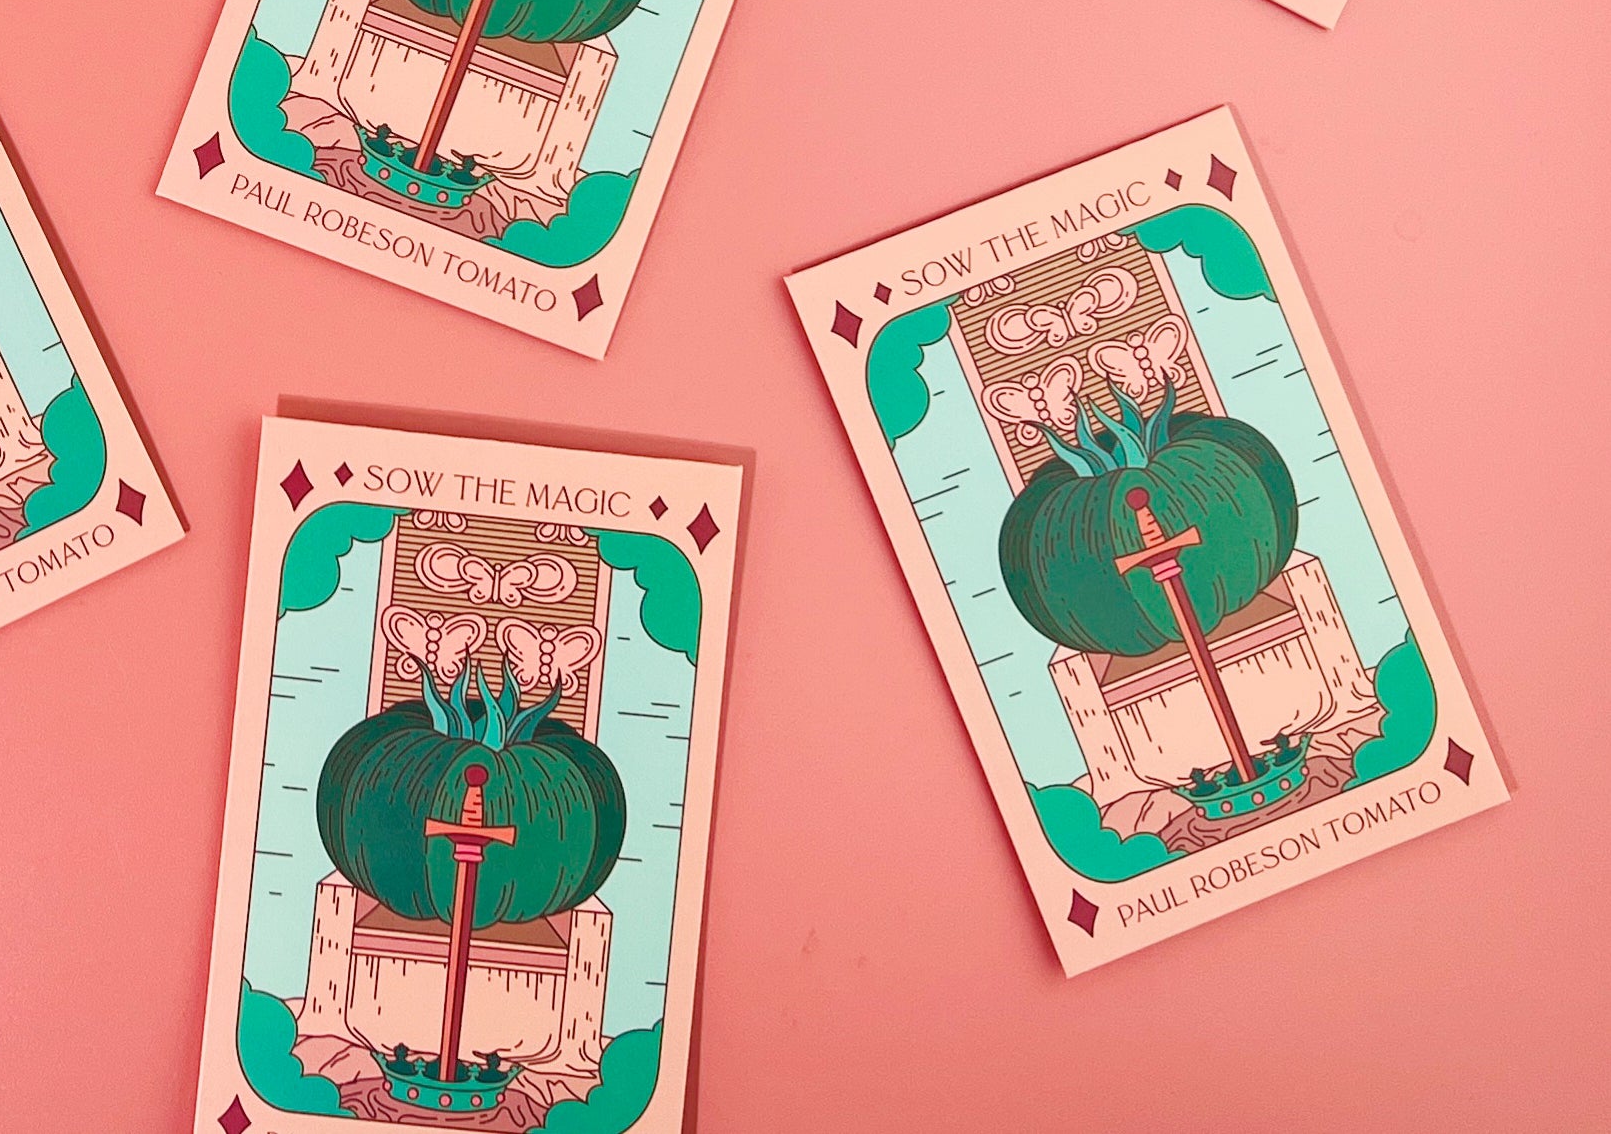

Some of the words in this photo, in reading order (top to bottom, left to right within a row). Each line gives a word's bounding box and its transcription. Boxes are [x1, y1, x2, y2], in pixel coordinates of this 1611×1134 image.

[230, 173, 295, 218] PAUL
[303, 201, 435, 268] ROBESON
[443, 251, 557, 312] TOMATO
[901, 247, 972, 296] SOW
[979, 221, 1048, 263] THE
[1050, 181, 1151, 239] MAGIC
[363, 464, 444, 497] SOW
[453, 474, 516, 506] THE
[525, 482, 631, 518] MAGIC
[1117, 886, 1189, 928] PAUL
[1189, 827, 1321, 899] ROBESON
[1322, 781, 1441, 842] TOMATO
